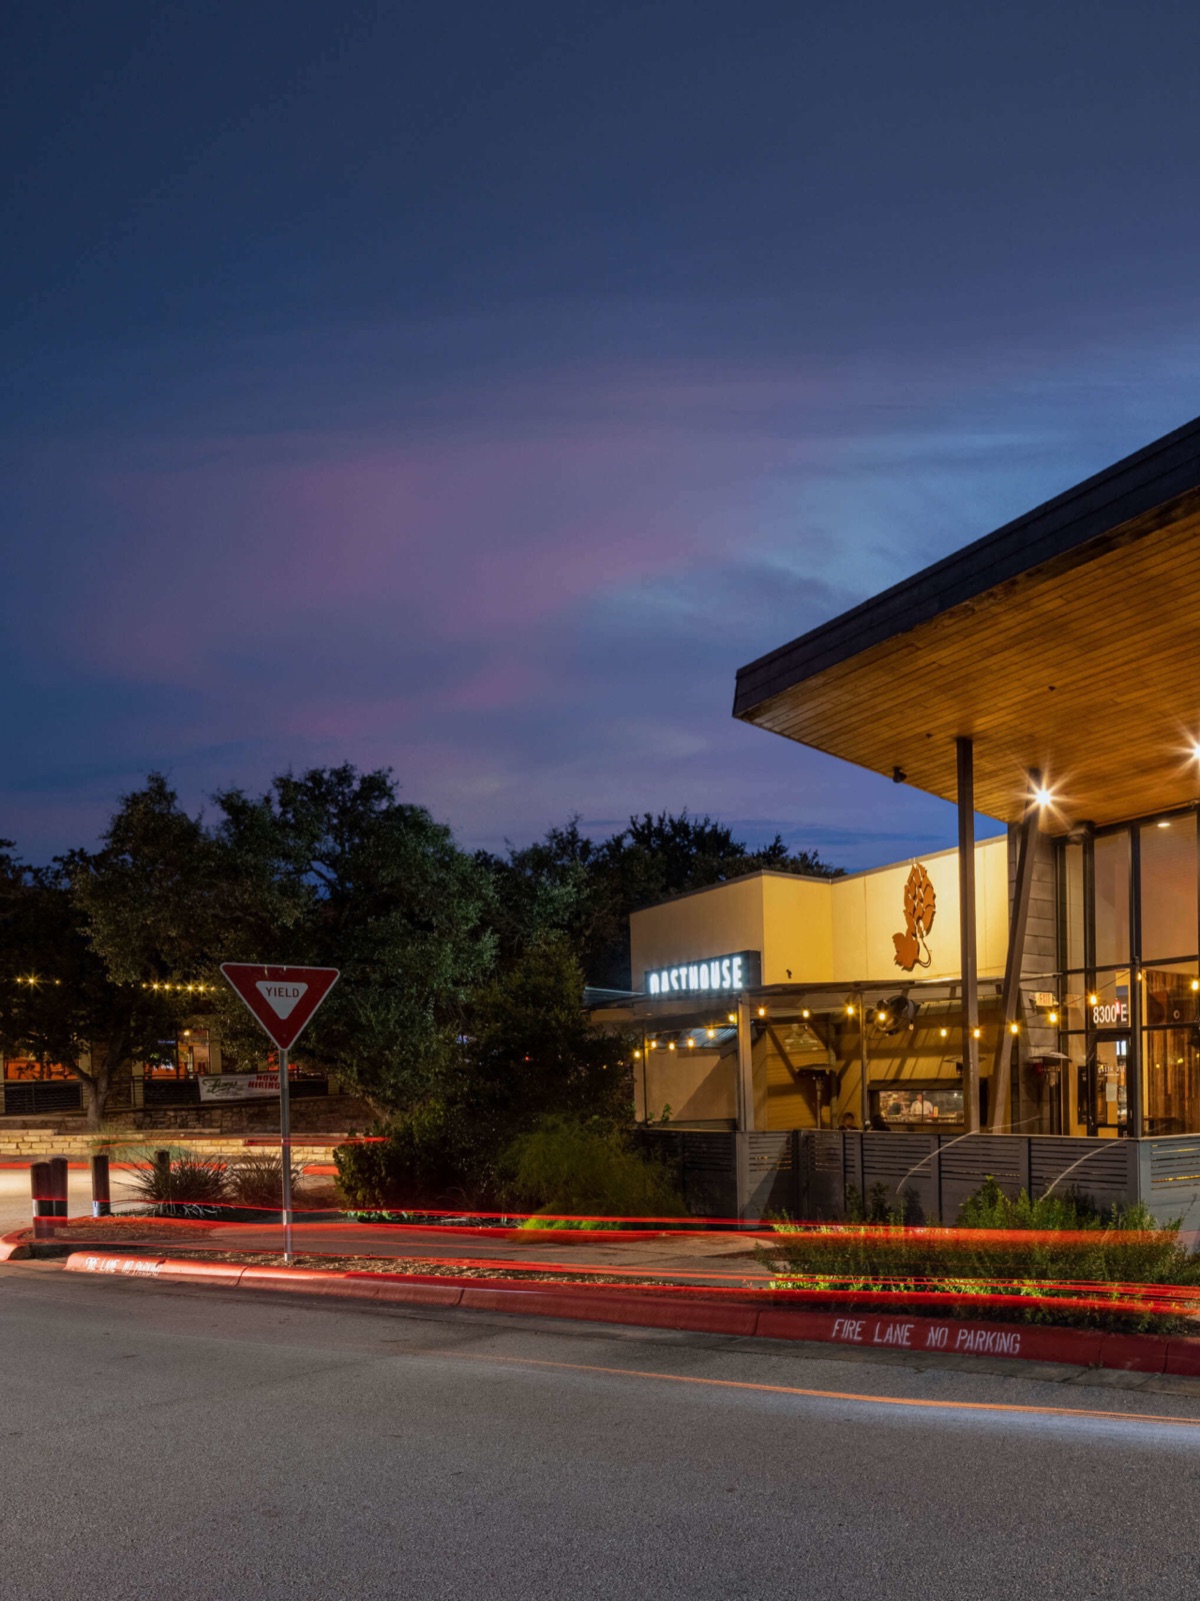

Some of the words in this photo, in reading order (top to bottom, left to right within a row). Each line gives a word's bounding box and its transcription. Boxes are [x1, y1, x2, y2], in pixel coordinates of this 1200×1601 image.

[649, 957, 743, 994] OASTHOUSE
[265, 986, 299, 998] YIELD
[1093, 1005, 1117, 1024] 8300
[248, 1080, 281, 1090] HIRING
[256, 1074, 279, 1082] NOW
[832, 1318, 866, 1341] FIRE
[873, 1322, 914, 1346] LANE
[926, 1326, 948, 1348] NO
[955, 1328, 1021, 1355] PARKING
